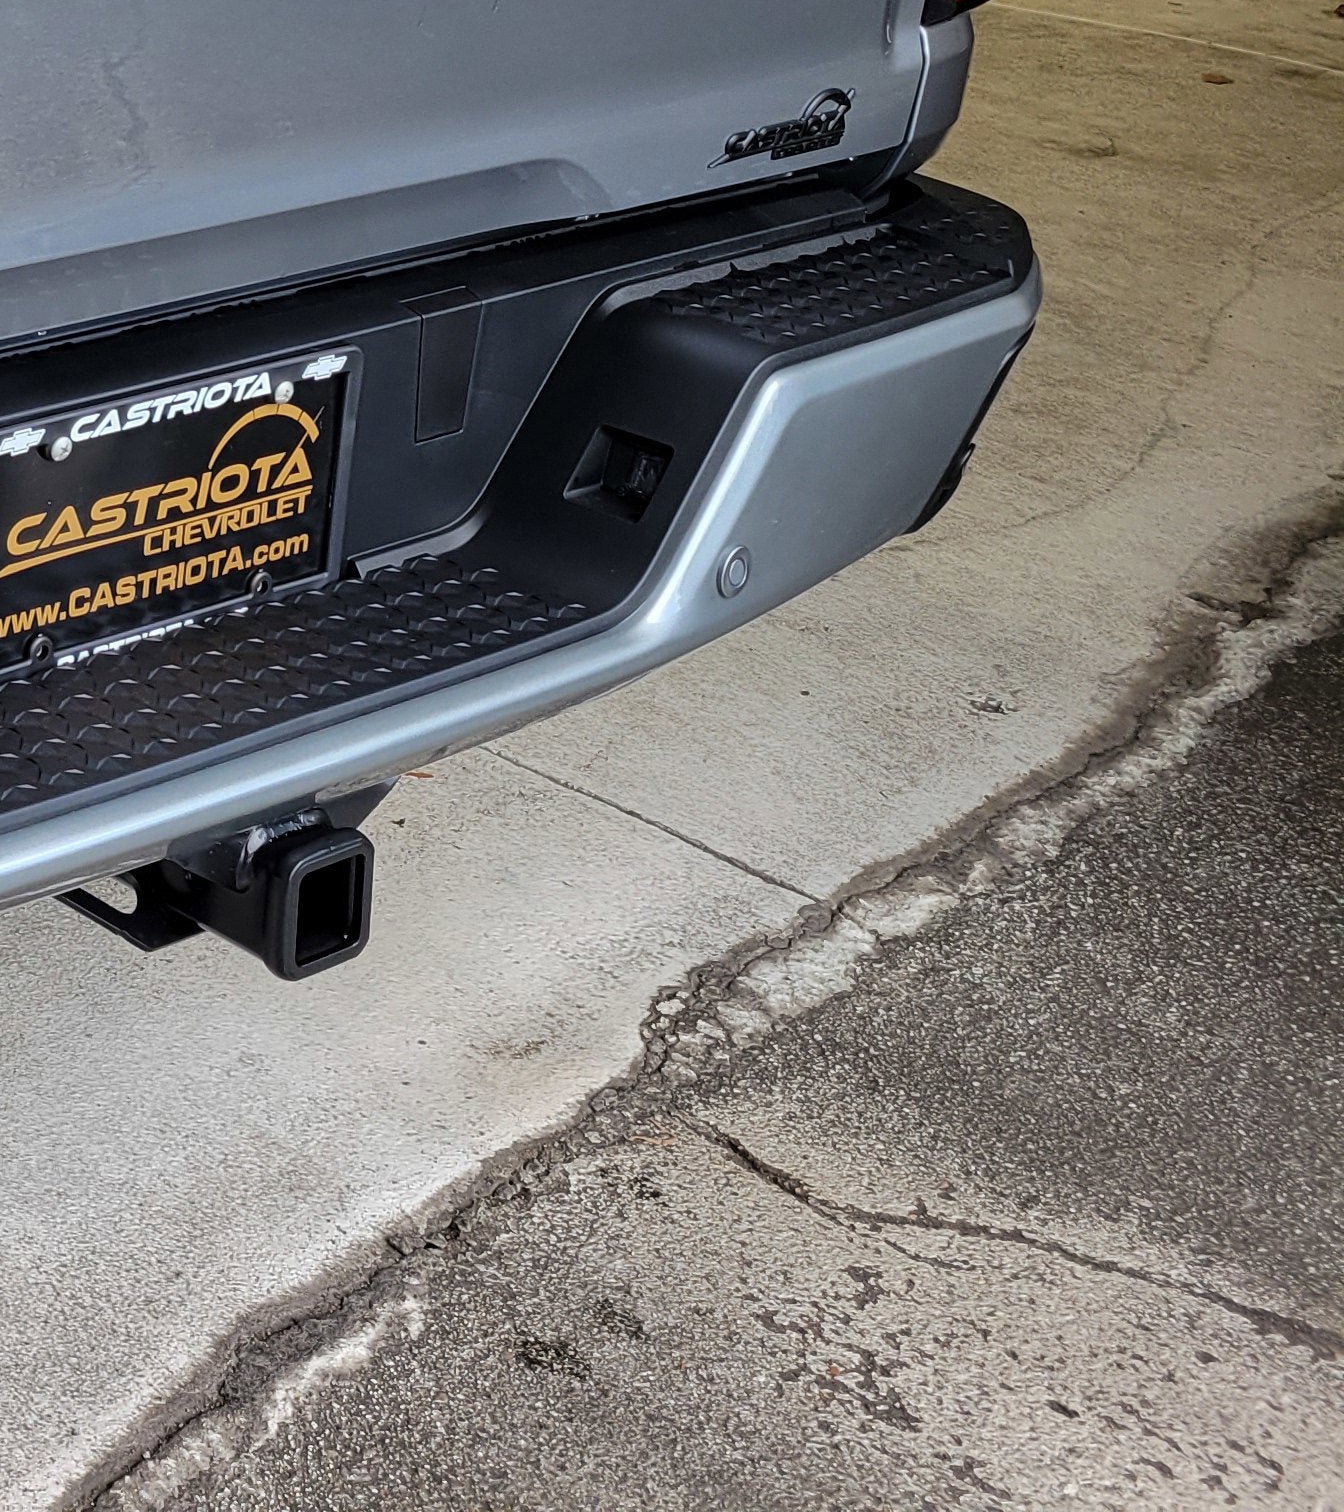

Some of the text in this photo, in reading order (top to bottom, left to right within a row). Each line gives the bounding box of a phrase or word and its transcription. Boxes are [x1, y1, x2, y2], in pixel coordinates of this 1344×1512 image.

[70, 371, 272, 443] CASTRIOTA
[6, 447, 313, 556] CASTRIOTA
[143, 491, 312, 557] CHEVROLET
